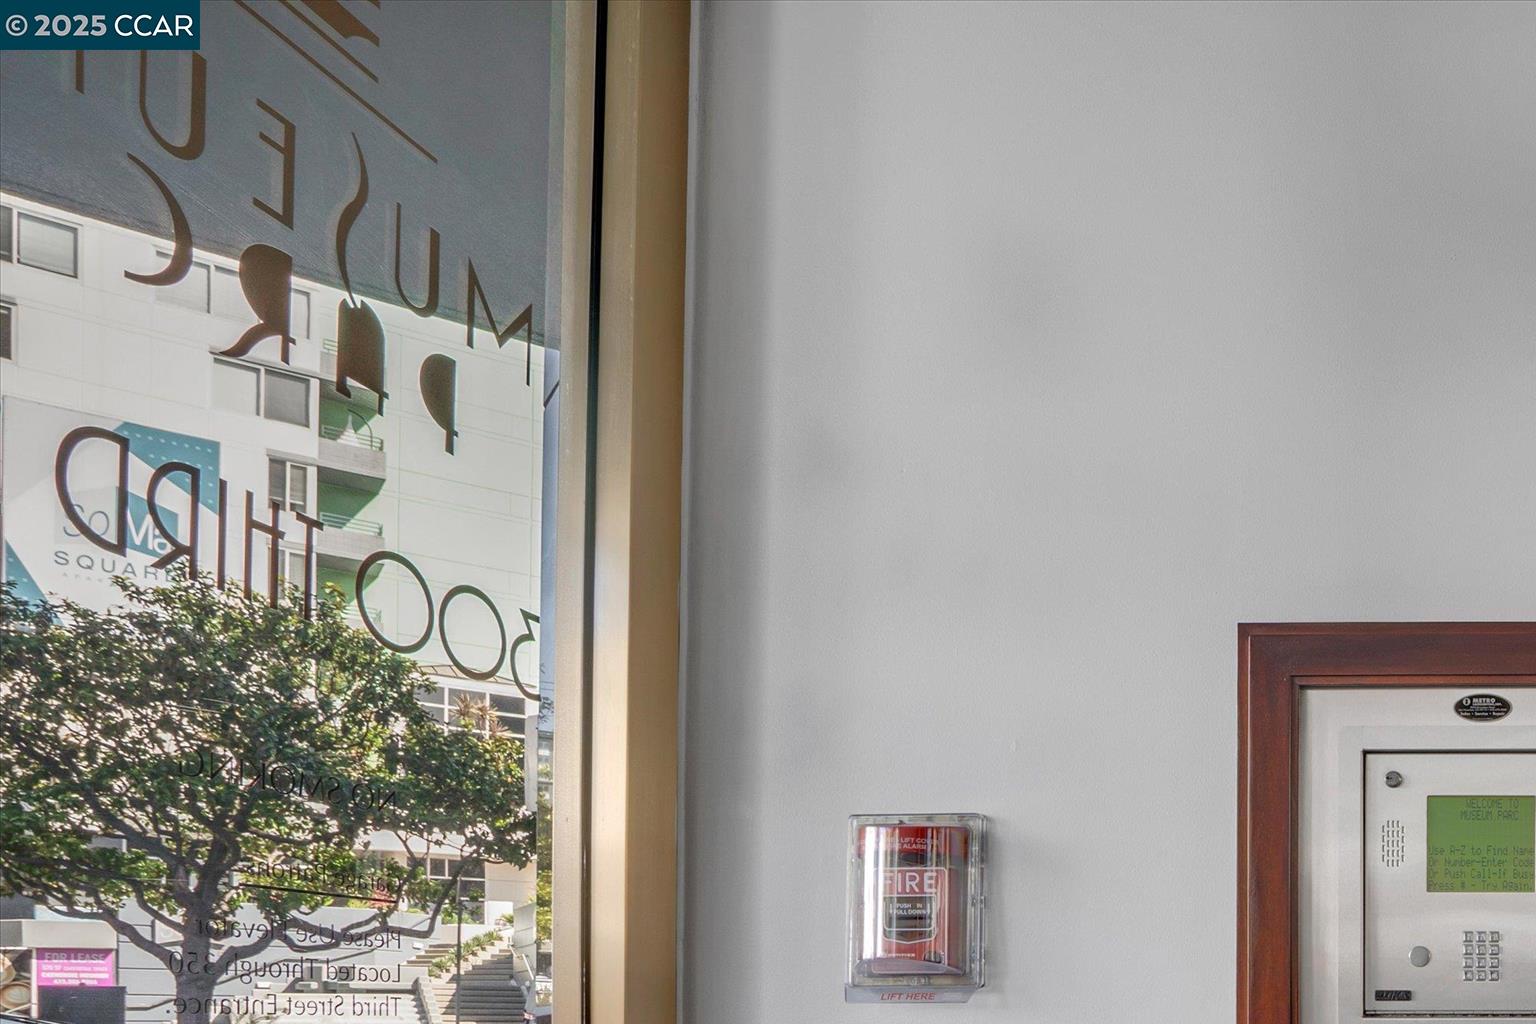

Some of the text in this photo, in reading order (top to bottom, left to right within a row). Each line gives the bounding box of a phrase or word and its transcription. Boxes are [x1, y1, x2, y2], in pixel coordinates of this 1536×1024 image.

[1466, 798, 1519, 809] WELCOME TO
[1460, 810, 1493, 821] MUSEUM
[1450, 845, 1466, 856] A-Z
[1471, 845, 1482, 856] to
[1487, 845, 1508, 856] Find
[1444, 868, 1466, 879] Push
[882, 871, 937, 893] FIRE
[1481, 880, 1498, 890] Try
[45, 953, 106, 964] FOR LEASE
[880, 991, 937, 1001] LIFT HERE
